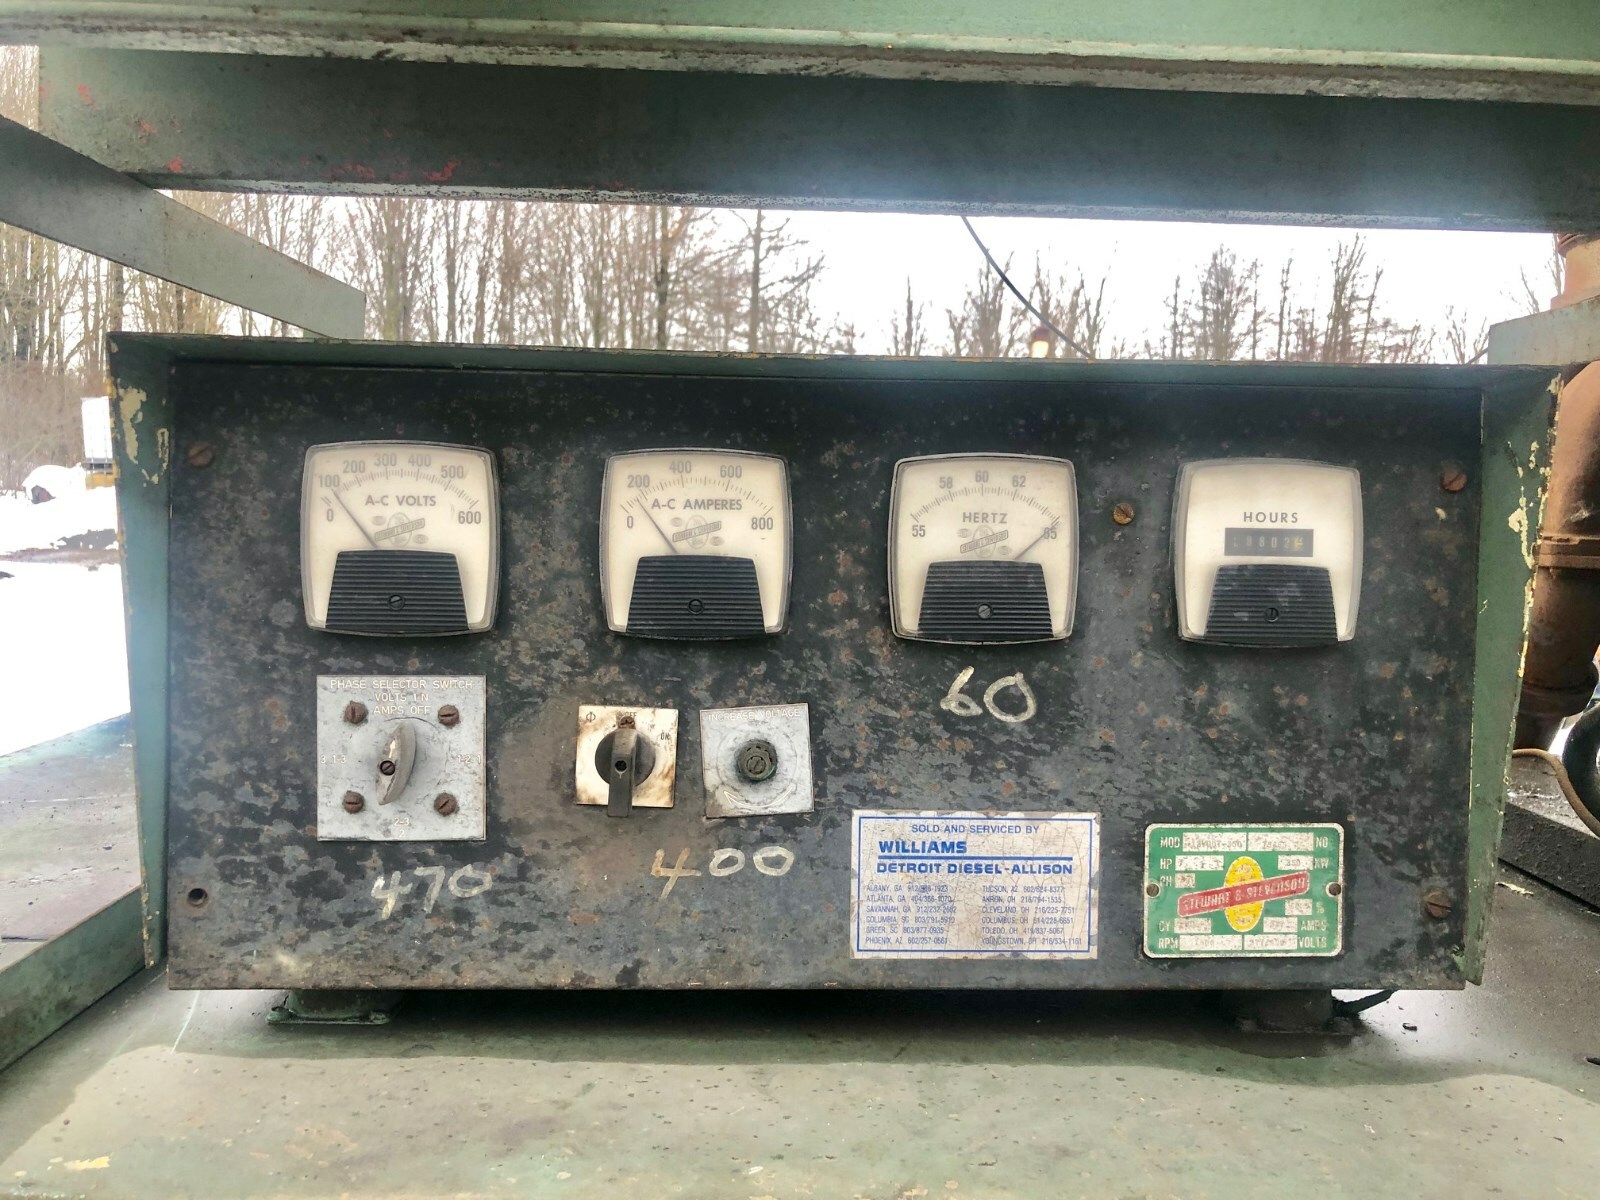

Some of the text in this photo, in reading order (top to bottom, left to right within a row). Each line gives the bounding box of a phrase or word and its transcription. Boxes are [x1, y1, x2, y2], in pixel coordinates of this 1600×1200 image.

[374, 453, 397, 467] 300
[408, 454, 431, 467] 400
[342, 460, 366, 474] 200
[440, 465, 464, 479] 500
[669, 460, 692, 474] 400
[720, 465, 742, 479] 600
[318, 474, 340, 488] 100
[627, 474, 650, 488] 200
[975, 470, 989, 483] 60
[1012, 475, 1026, 488] 62
[939, 477, 953, 489] 58
[365, 495, 436, 507] A-C VOLTS
[651, 498, 742, 511] A-C AMPERES
[326, 508, 334, 522] 0
[458, 511, 482, 524] 600
[962, 512, 1008, 524] HERTZ
[1243, 511, 1298, 523] HOURS
[626, 515, 634, 529] 0
[751, 517, 774, 530] 800
[912, 525, 926, 537] 55
[330, 680, 473, 689] PHASE SELECTOR SWITCH
[375, 693, 407, 702] VOLTS
[940, 666, 1037, 722] 60
[373, 706, 432, 715] AMPS OFF
[708, 709, 801, 721] INCREASE VOLTAGE
[394, 817, 410, 826] 2-3
[911, 824, 1040, 834] SOLD AND SERVICED BY
[879, 841, 968, 854] WILLIAMS
[1160, 837, 1180, 848] MOD
[1316, 837, 1328, 847] NO
[877, 862, 1073, 875] DETROIT DIESEL-ALLISON
[1160, 858, 1172, 870] HP
[1314, 858, 1328, 869] KW
[650, 846, 795, 900] 400
[1160, 875, 1172, 886] PH
[371, 864, 493, 920] 470
[1183, 877, 1305, 911] STEWART & STEVENSON
[898, 895, 906, 903] GA
[903, 905, 911, 913] GA
[1159, 921, 1170, 932] CY
[1301, 919, 1327, 931] AMPS
[1158, 938, 1178, 949] RPM
[1299, 936, 1327, 948] VOLTS
